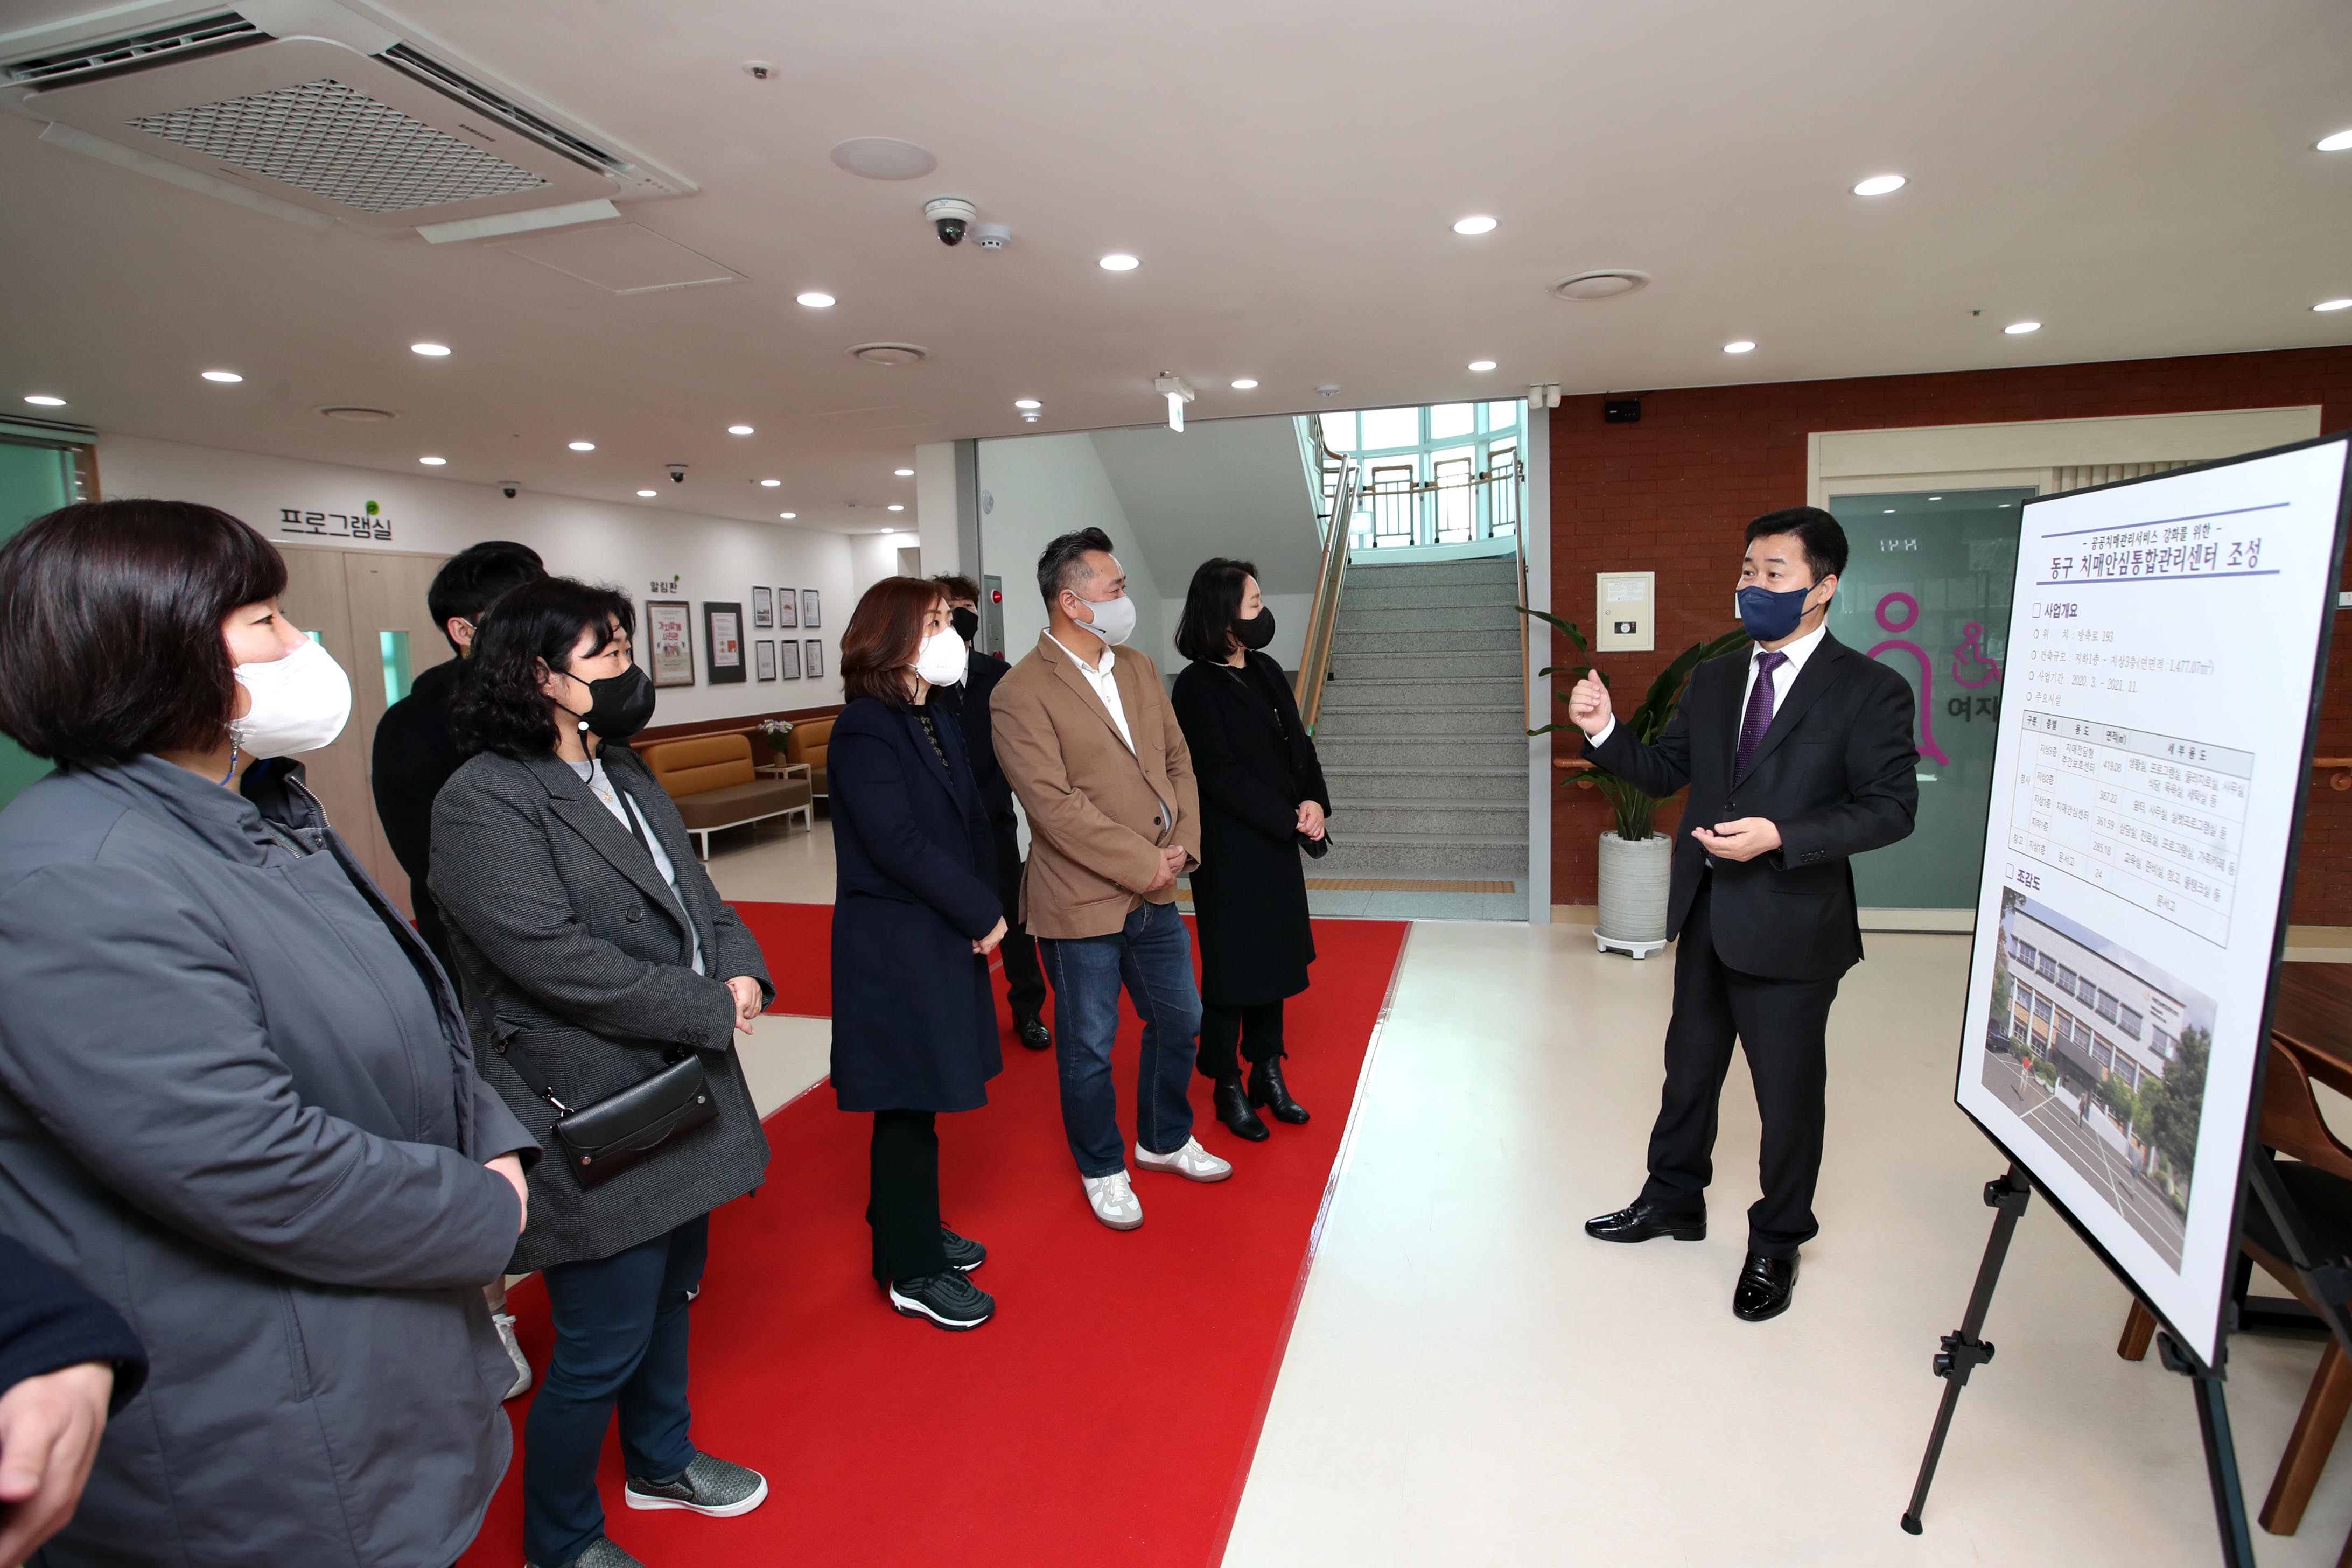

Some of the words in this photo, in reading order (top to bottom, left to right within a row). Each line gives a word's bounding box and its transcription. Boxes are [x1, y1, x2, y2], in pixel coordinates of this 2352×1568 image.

[280, 508, 393, 541] 프로그램실
[2091, 530, 2158, 550] 공공치매관리서비스
[2164, 526, 2188, 543] 강화를
[2193, 523, 2211, 540] 위한
[2051, 557, 2073, 579] 동구
[2080, 542, 2218, 578] 치매안심통합관리센터
[2227, 538, 2262, 568] 조성
[650, 581, 677, 593] 알림판
[2044, 603, 2078, 619] 사업개요
[2042, 628, 2049, 640] 위
[2062, 629, 2069, 641] 치
[2078, 629, 2098, 642] 방축로
[2102, 631, 2114, 642] 193
[2041, 649, 2066, 662] 건축규모
[2076, 652, 2099, 666] 지하1층
[2038, 670, 2064, 684] 사업기간
[2035, 691, 2061, 706] 주요시설
[1948, 695, 1999, 722] 여자
[2027, 715, 2038, 726] 구분
[2046, 719, 2057, 730] 층별
[2040, 744, 2057, 757] 지상3층
[2062, 755, 2095, 773] 주간보호센터
[2037, 772, 2054, 786] 지상2층
[2034, 794, 2052, 809] 지상1층
[2099, 790, 2118, 804] 387.22
[2056, 802, 2089, 822] 치매안심센터
[2031, 817, 2049, 832] 지하1층
[2096, 816, 2115, 830] 361.59
[2092, 841, 2111, 856] 285.18
[2028, 840, 2046, 856] 지상1층
[2058, 852, 2075, 866] 문서고
[2094, 868, 2102, 879] 24
[2017, 869, 2041, 891] 조감도
